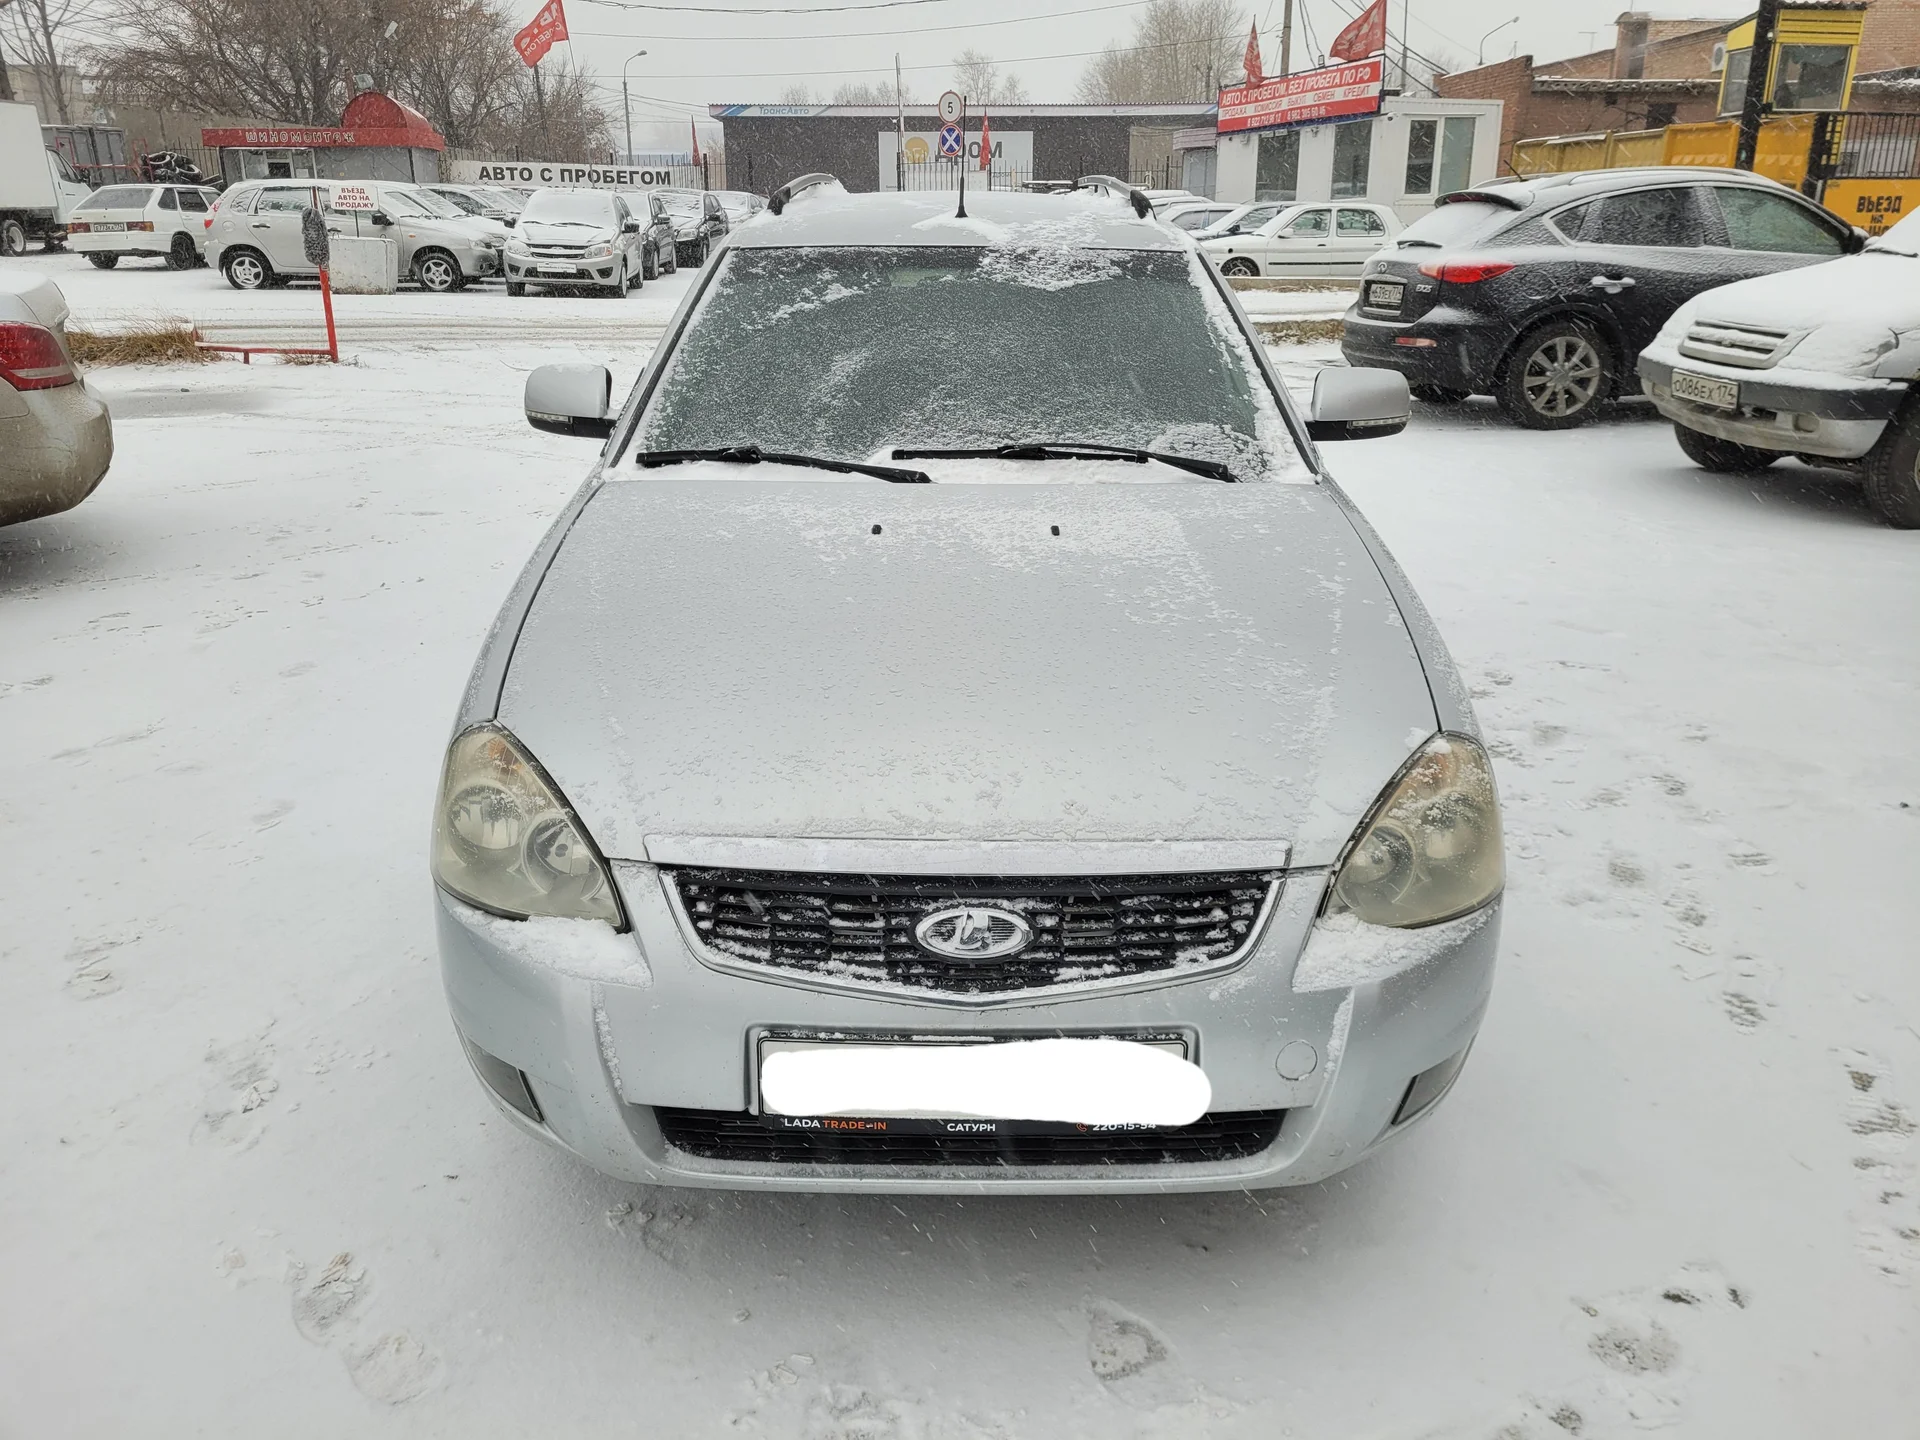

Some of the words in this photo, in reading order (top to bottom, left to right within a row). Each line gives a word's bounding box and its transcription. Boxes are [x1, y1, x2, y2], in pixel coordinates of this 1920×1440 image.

[1221, 91, 1240, 106] АВТО
[1241, 91, 1248, 103] С
[1288, 79, 1304, 94] БЕЗ
[1304, 71, 1341, 91] ПРОБЕГА
[1341, 69, 1356, 85] ПО
[1356, 66, 1371, 82] РФ
[1221, 106, 1247, 118] ПРОДАЖА
[1313, 90, 1336, 103] ОБМЕН
[1343, 84, 1371, 98] КРЕДИТ
[759, 106, 810, 115] ТрансАвто
[947, 101, 954, 115] 5
[246, 131, 356, 143] ШИНОМОНТАЖ
[478, 165, 533, 182] АВТО
[540, 167, 553, 182] С
[560, 168, 671, 186] ПРОБЕГОМ
[341, 187, 366, 195] ВЪЕЗД
[335, 201, 375, 209] ПРОДАЖУ
[1870, 214, 1884, 224] НА
[784, 1118, 821, 1128] LADA
[822, 1119, 887, 1130] TRADE-IN
[946, 1123, 996, 1132] САТУРН
